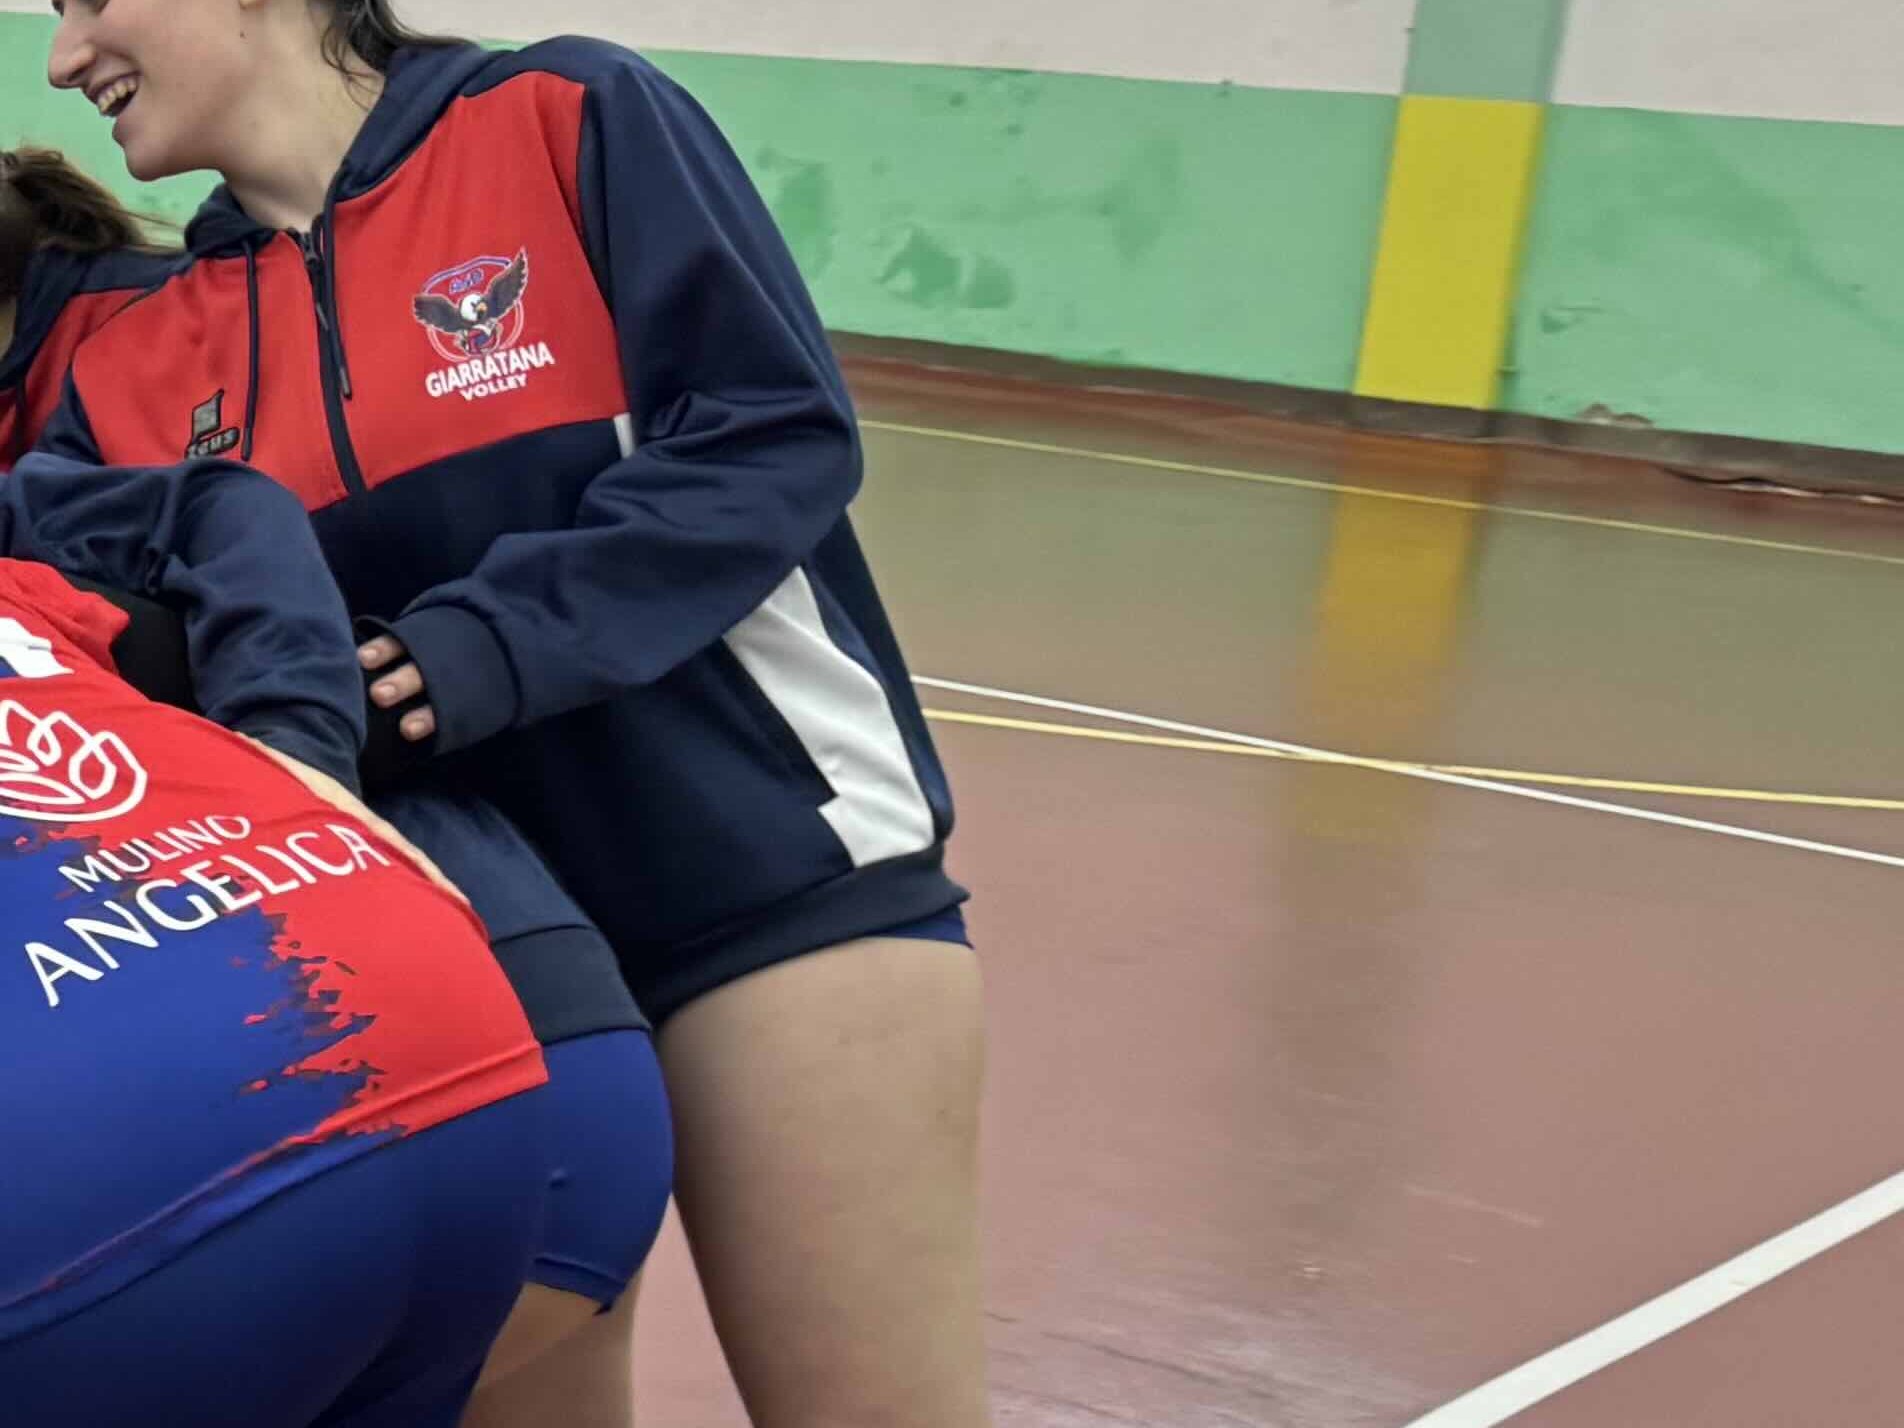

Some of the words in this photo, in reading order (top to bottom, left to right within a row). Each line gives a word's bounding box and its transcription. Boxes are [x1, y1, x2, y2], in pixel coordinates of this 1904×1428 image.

[425, 341, 556, 398] GIARRATANA
[460, 373, 528, 402] VOLLEY
[58, 815, 252, 893] MULINO
[24, 823, 391, 1008] ANGELICA
